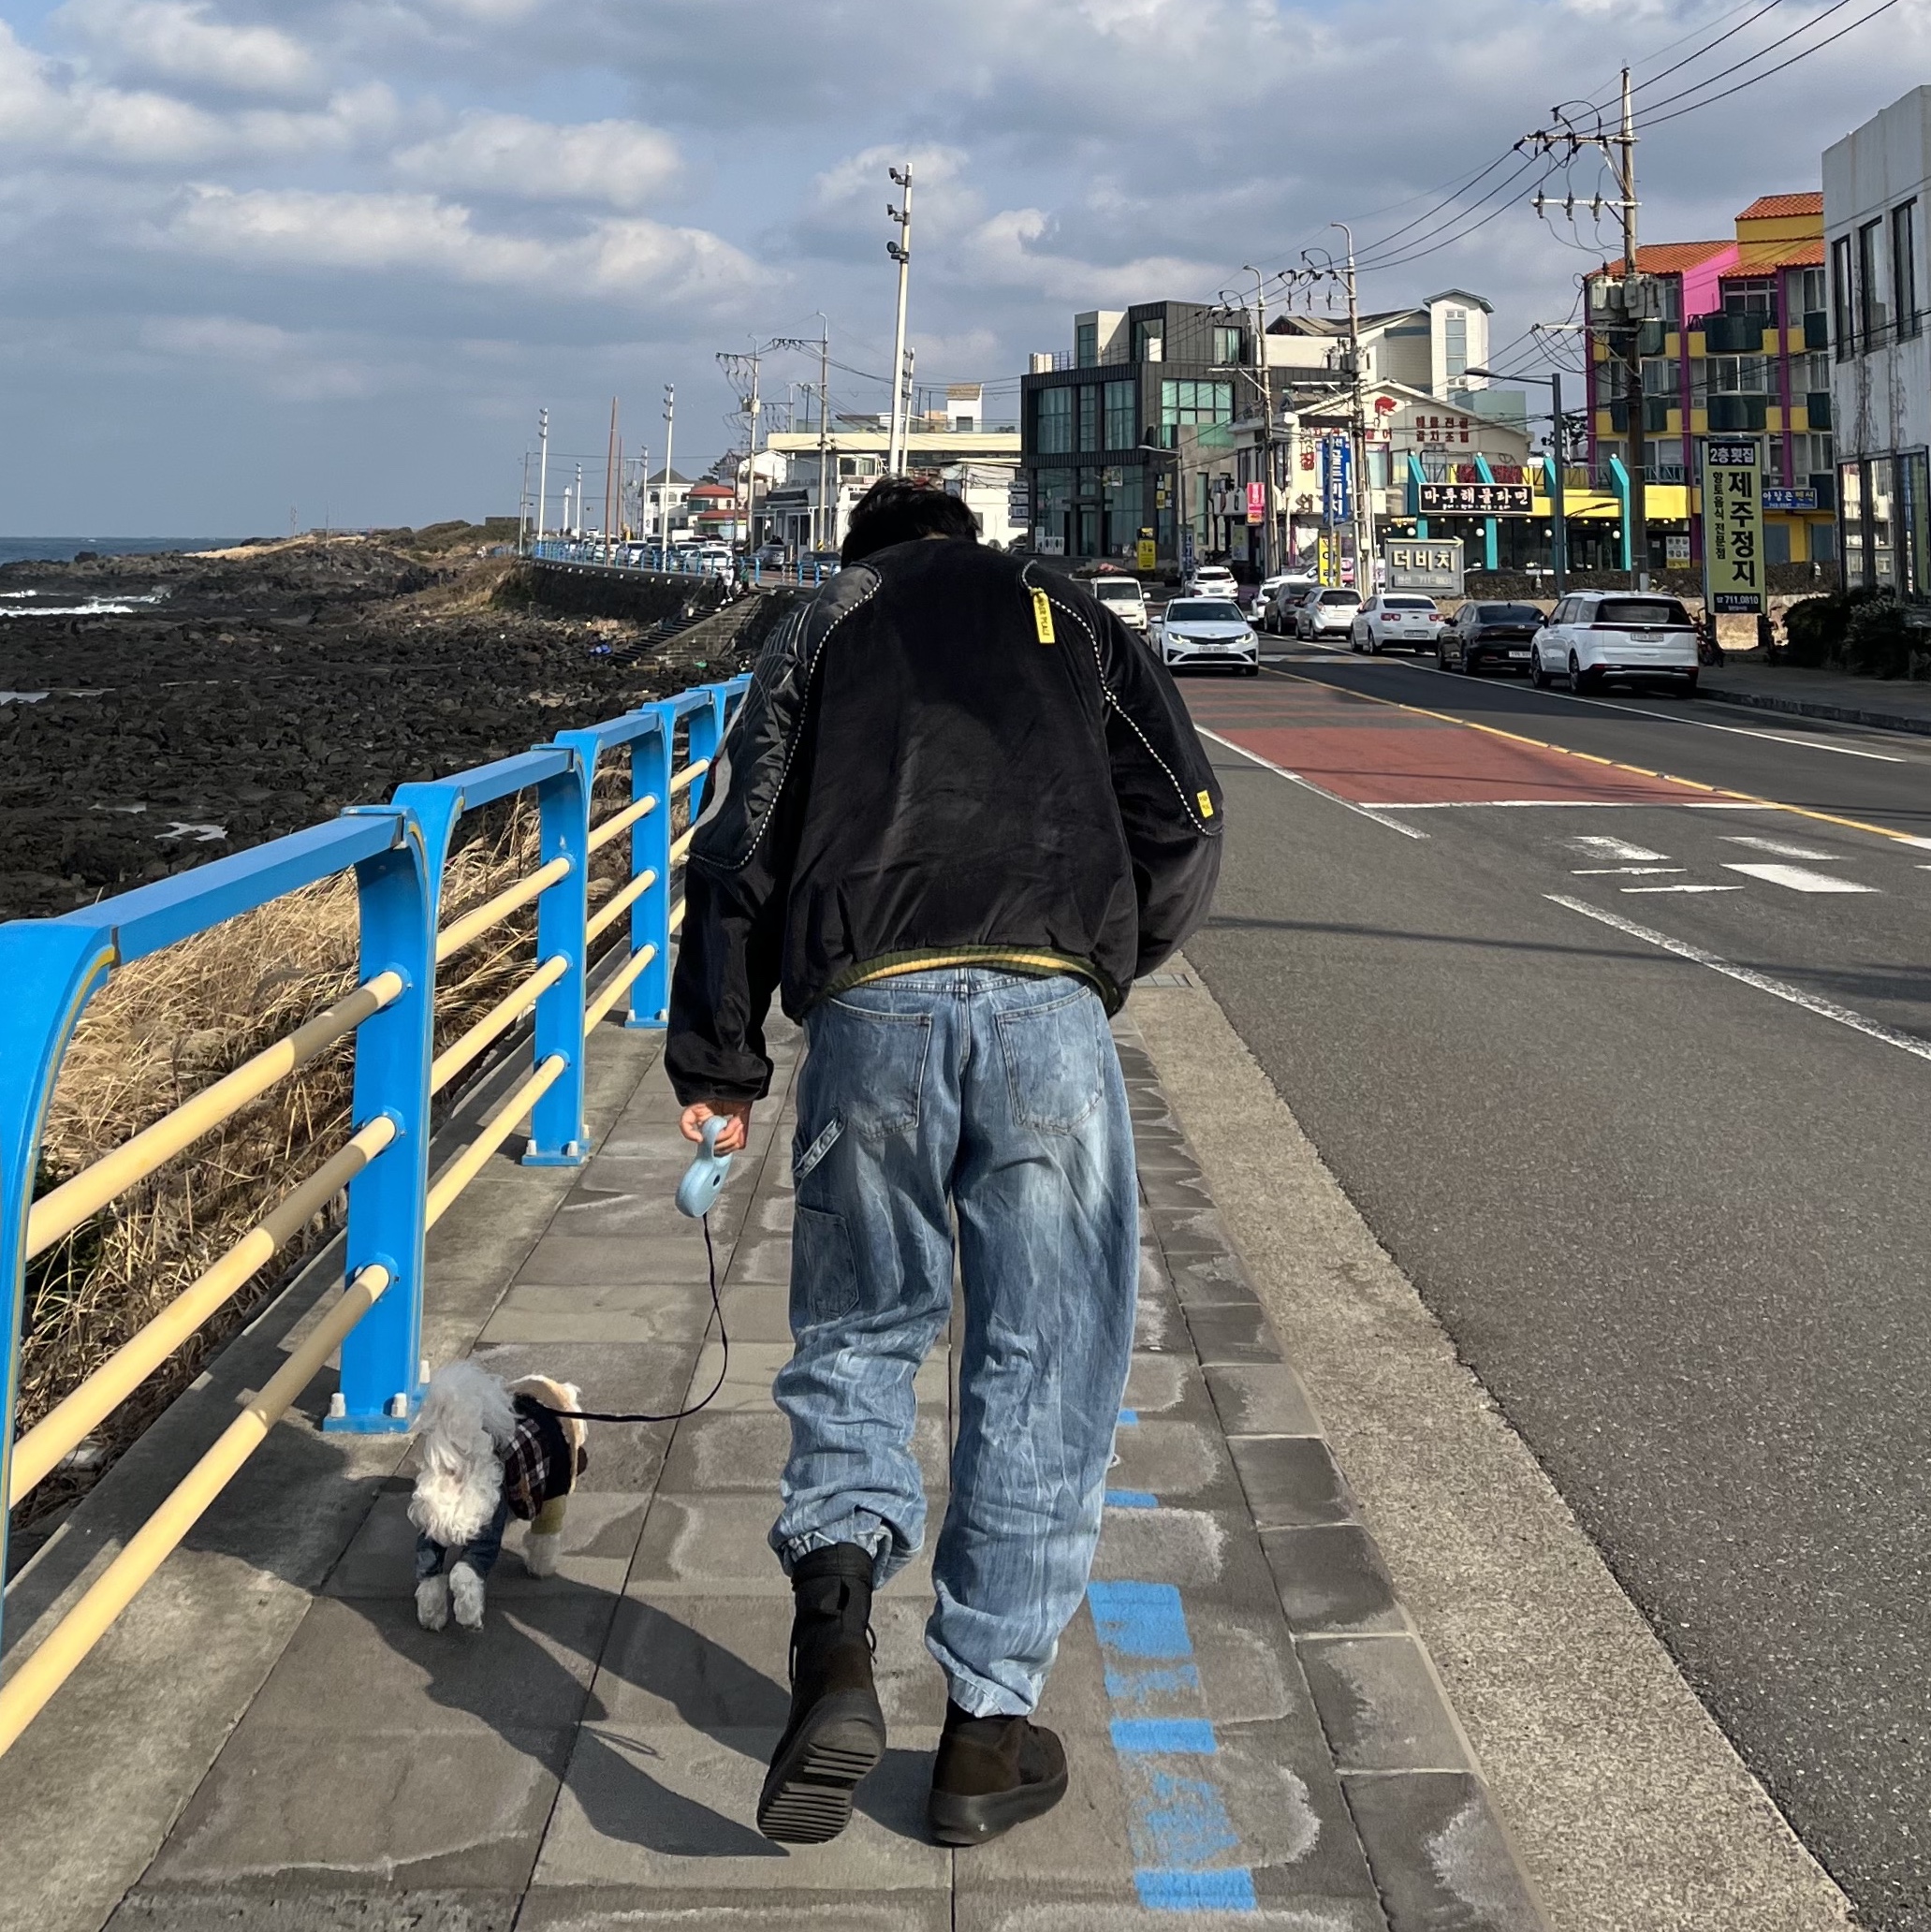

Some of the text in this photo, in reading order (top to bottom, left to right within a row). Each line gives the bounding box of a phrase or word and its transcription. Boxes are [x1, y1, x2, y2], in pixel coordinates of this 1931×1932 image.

[1710, 447, 1754, 463] 2층 횟집
[1728, 472, 1755, 587] 제주정지
[1393, 549, 1455, 571] 더비치
